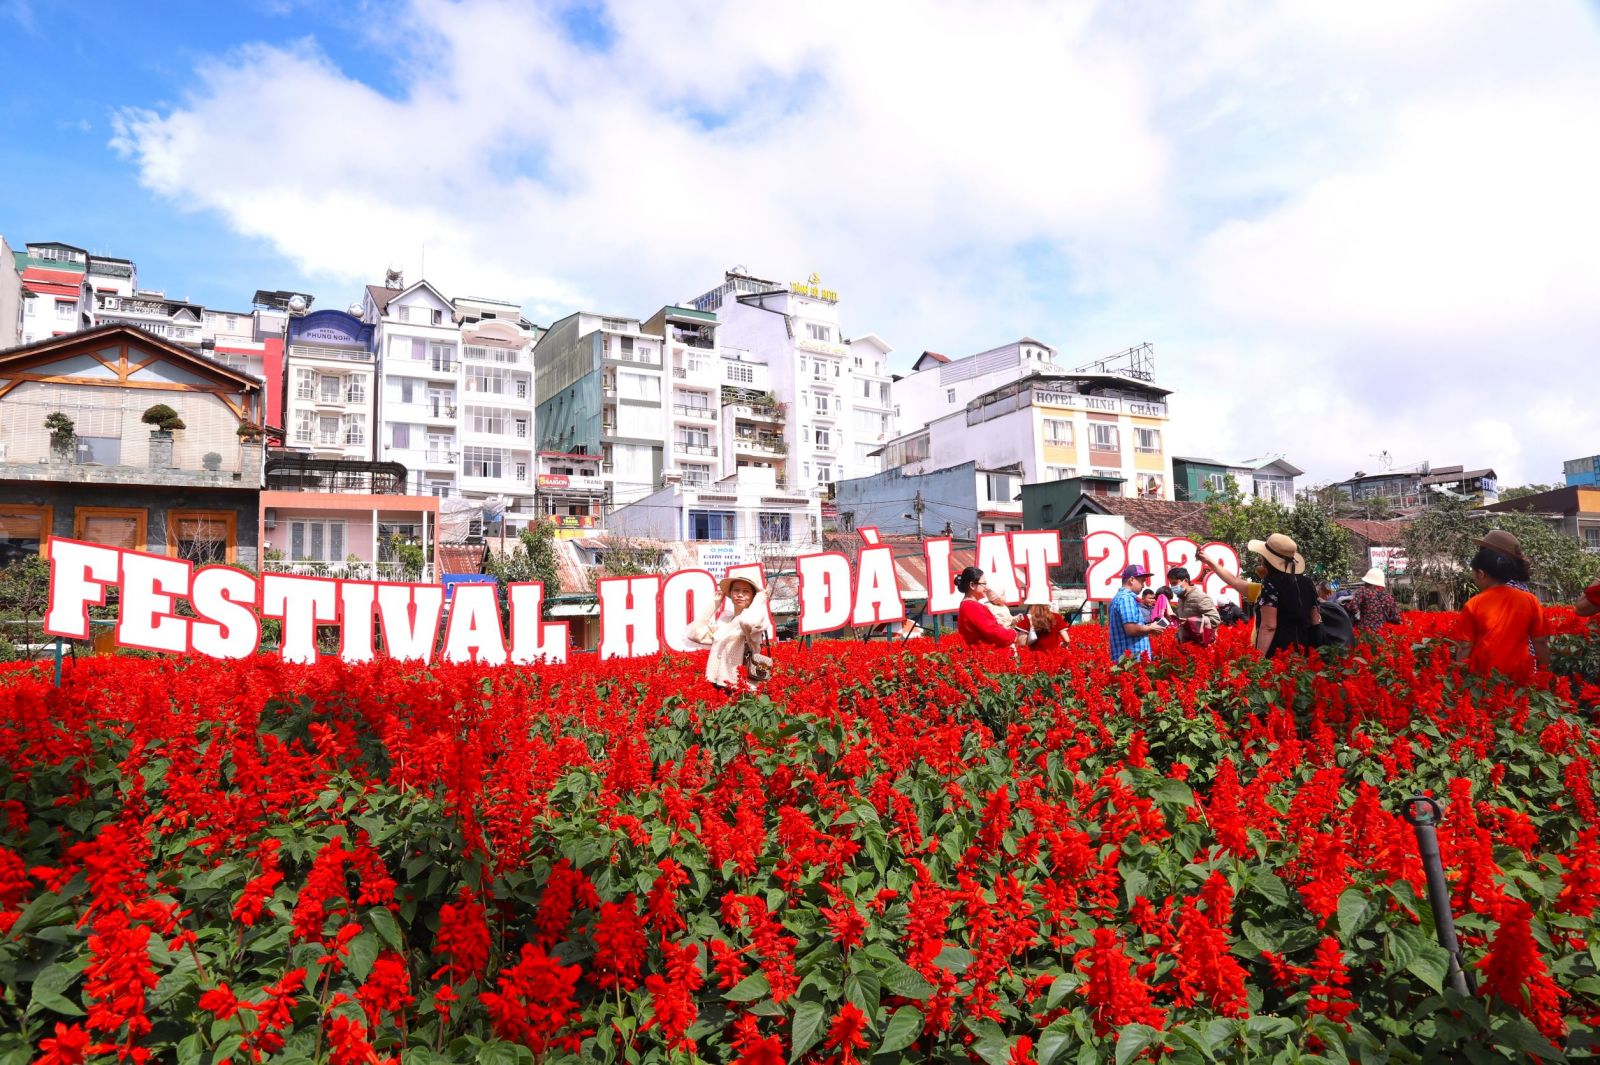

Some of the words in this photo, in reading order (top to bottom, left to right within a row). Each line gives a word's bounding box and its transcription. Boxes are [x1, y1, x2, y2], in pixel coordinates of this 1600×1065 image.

[1035, 391, 1076, 406] HOTEL
[1085, 398, 1115, 411] MINH
[1130, 403, 1160, 417] CHÂU
[44, 535, 569, 666] FESTIVAL
[596, 562, 777, 662] HOA
[797, 526, 906, 635] ĐÀ
[1083, 531, 1242, 609] 2022
